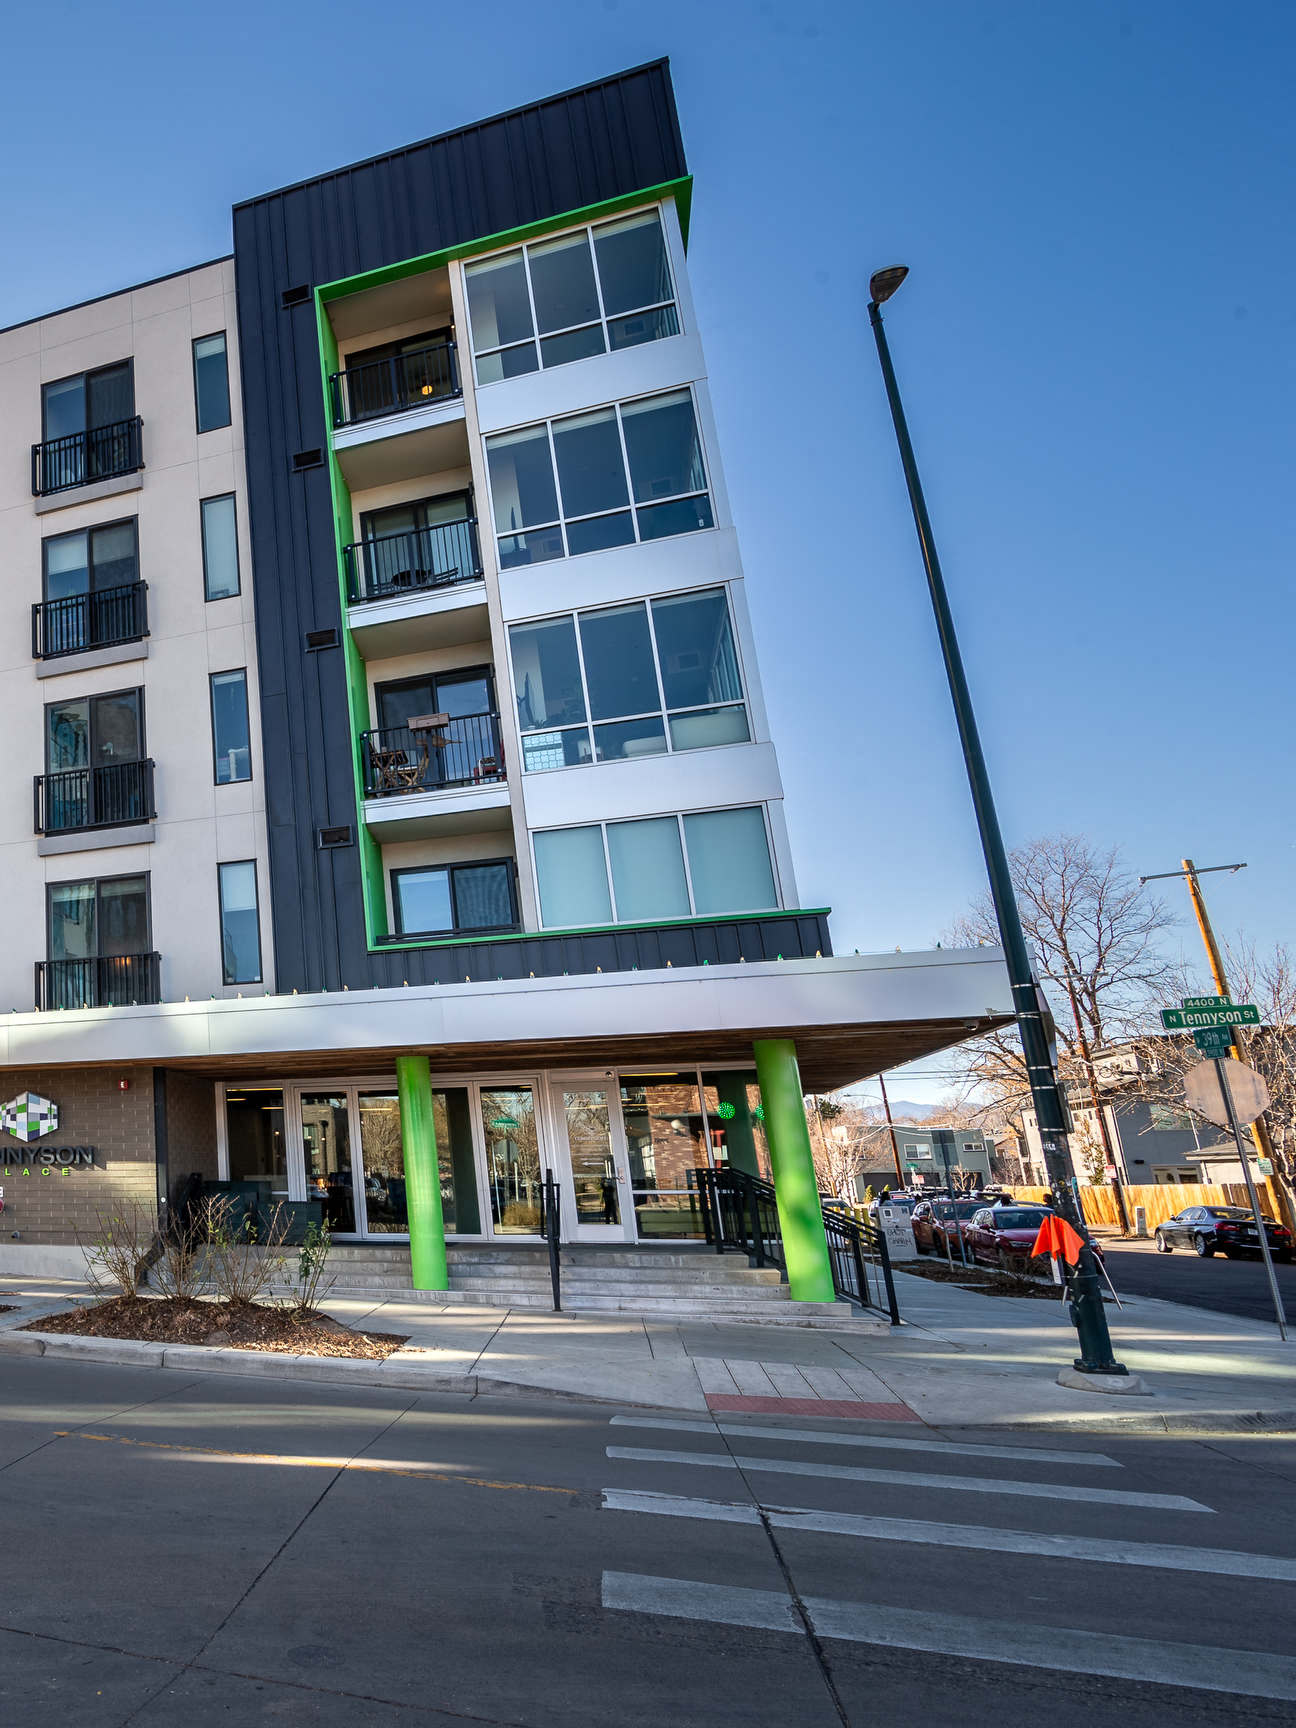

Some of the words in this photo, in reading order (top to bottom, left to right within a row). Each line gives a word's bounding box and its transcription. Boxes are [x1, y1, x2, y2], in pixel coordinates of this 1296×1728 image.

[1187, 998, 1215, 1007] 4400
[1169, 1015, 1177, 1023] N
[1178, 1010, 1243, 1025] Tennyson
[1243, 1010, 1255, 1019] St
[1202, 1031, 1220, 1046] 39th
